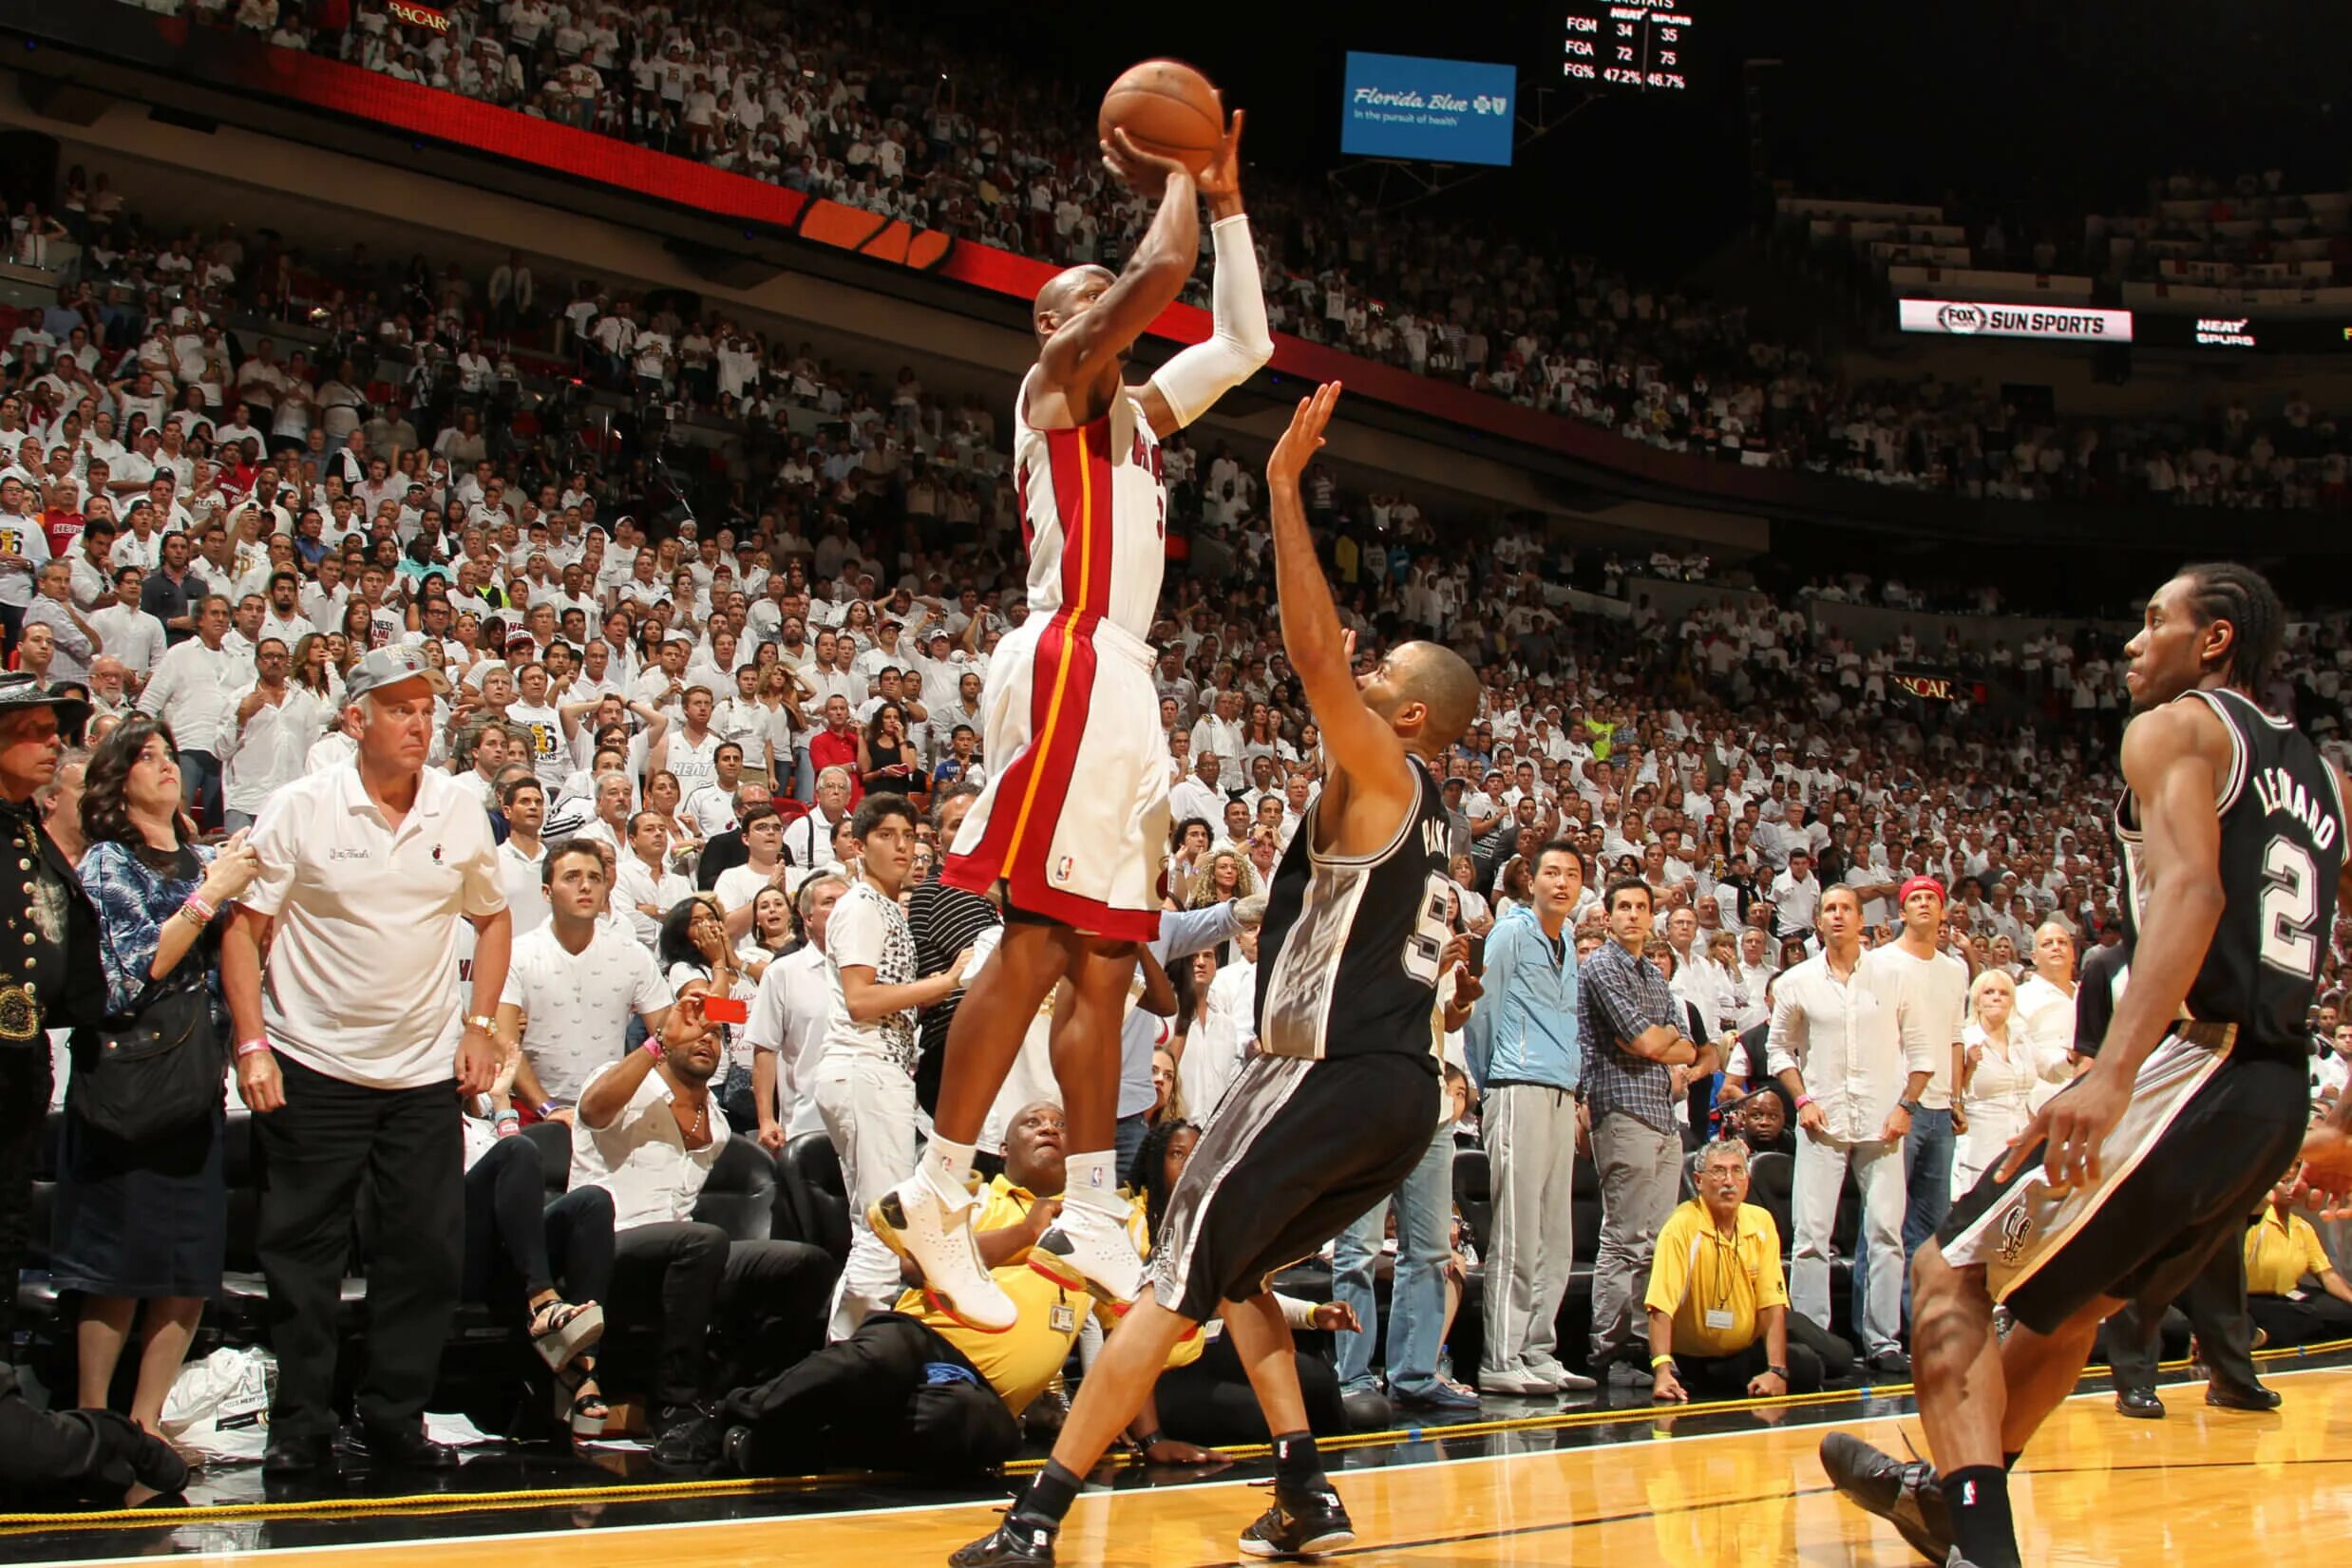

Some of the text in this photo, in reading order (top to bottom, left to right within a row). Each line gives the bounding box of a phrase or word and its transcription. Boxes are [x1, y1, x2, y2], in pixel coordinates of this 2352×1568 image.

[1610, 7, 1693, 26] HEAT SPURS
[1566, 16, 1679, 43] FGM 34 35
[1565, 40, 1677, 66] FGA 72 75
[1564, 62, 1685, 89] FG% 47.2% 46.7%
[1354, 87, 1469, 112] Florida Blue
[1354, 109, 1458, 127] In the pursuit of health
[1948, 308, 1977, 322] FOX
[1990, 311, 2106, 333] SUN SPORTS
[2196, 318, 2248, 332] HEAT
[2196, 332, 2256, 347] SPURS
[371, 619, 395, 632] NESS
[673, 761, 713, 777] HEAT
[2260, 833, 2319, 982] 2
